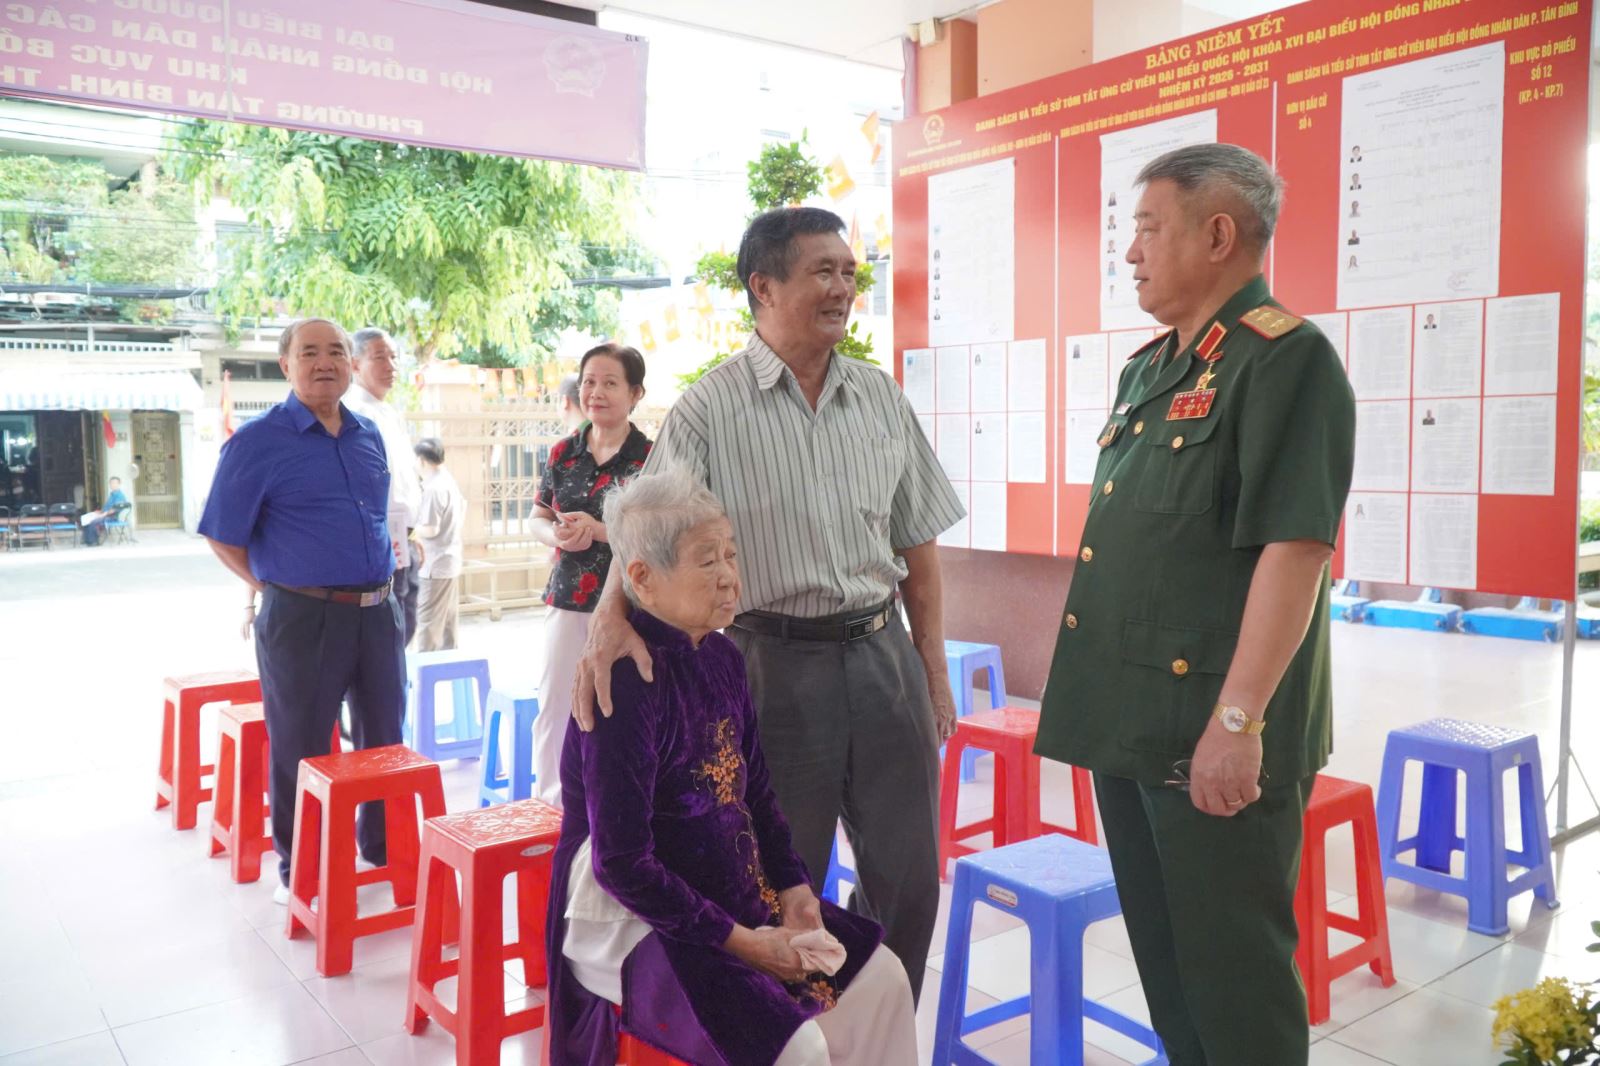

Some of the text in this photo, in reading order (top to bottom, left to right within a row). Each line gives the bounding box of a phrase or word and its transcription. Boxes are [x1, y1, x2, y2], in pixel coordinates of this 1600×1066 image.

[1135, 74, 1156, 89] VIÊN
[1202, 53, 1229, 72] QUỐC
[1232, 48, 1250, 64] HỘI
[1286, 34, 1304, 49] XVI
[1306, 28, 1326, 44] ĐẠI
[1329, 17, 1357, 37] BIỂU
[1360, 13, 1381, 29] HỘI
[1385, 3, 1420, 22] ĐỒNG
[1146, 15, 1285, 69] BẢNG NIÊM YẾT
[1554, 34, 1576, 54] PHIẾU
[1209, 69, 1234, 86] 2026
[1244, 61, 1269, 76] 2031
[1531, 62, 1552, 81] SỐ 12
[1533, 88, 1538, 101] 4
